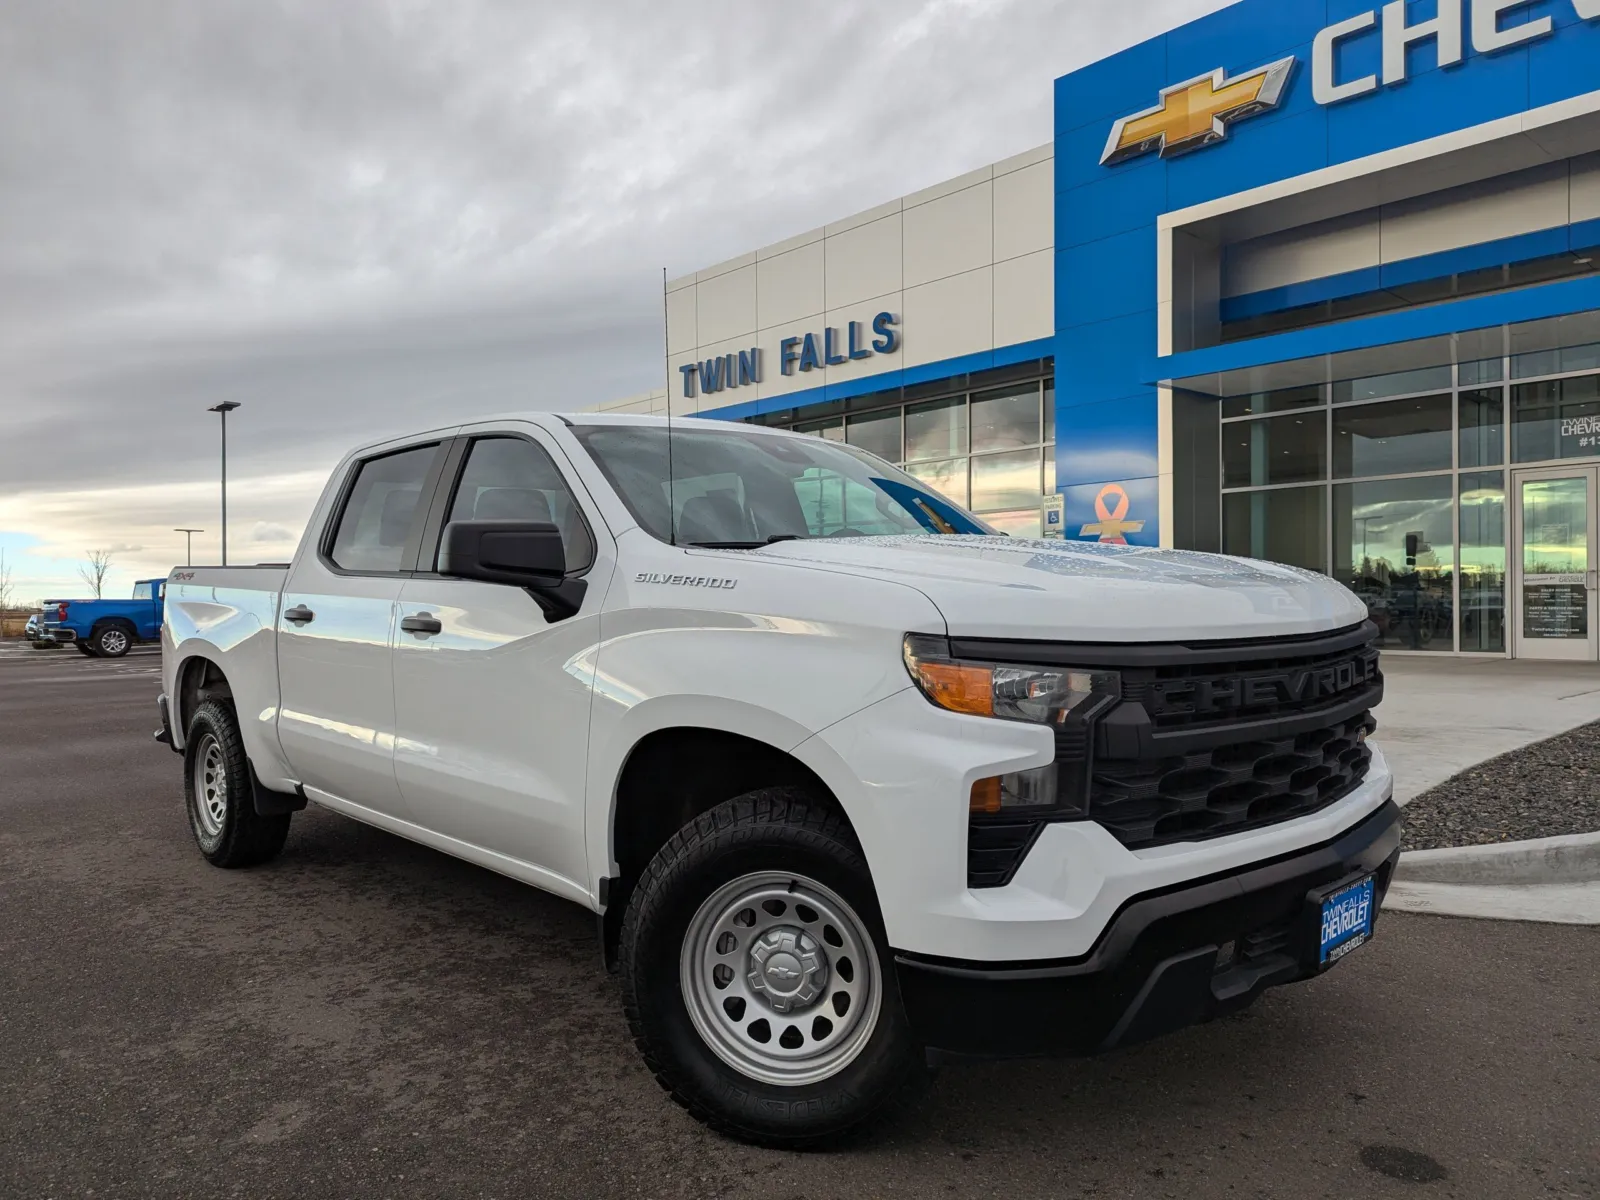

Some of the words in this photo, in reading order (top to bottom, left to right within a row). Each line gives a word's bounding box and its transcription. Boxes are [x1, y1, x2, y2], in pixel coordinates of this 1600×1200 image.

[1312, 0, 1600, 105] CHE
[679, 347, 762, 399] TWIN
[780, 311, 900, 376] FALLS
[634, 572, 738, 589] SILVERADO
[1321, 902, 1369, 944] CHEVROLET
